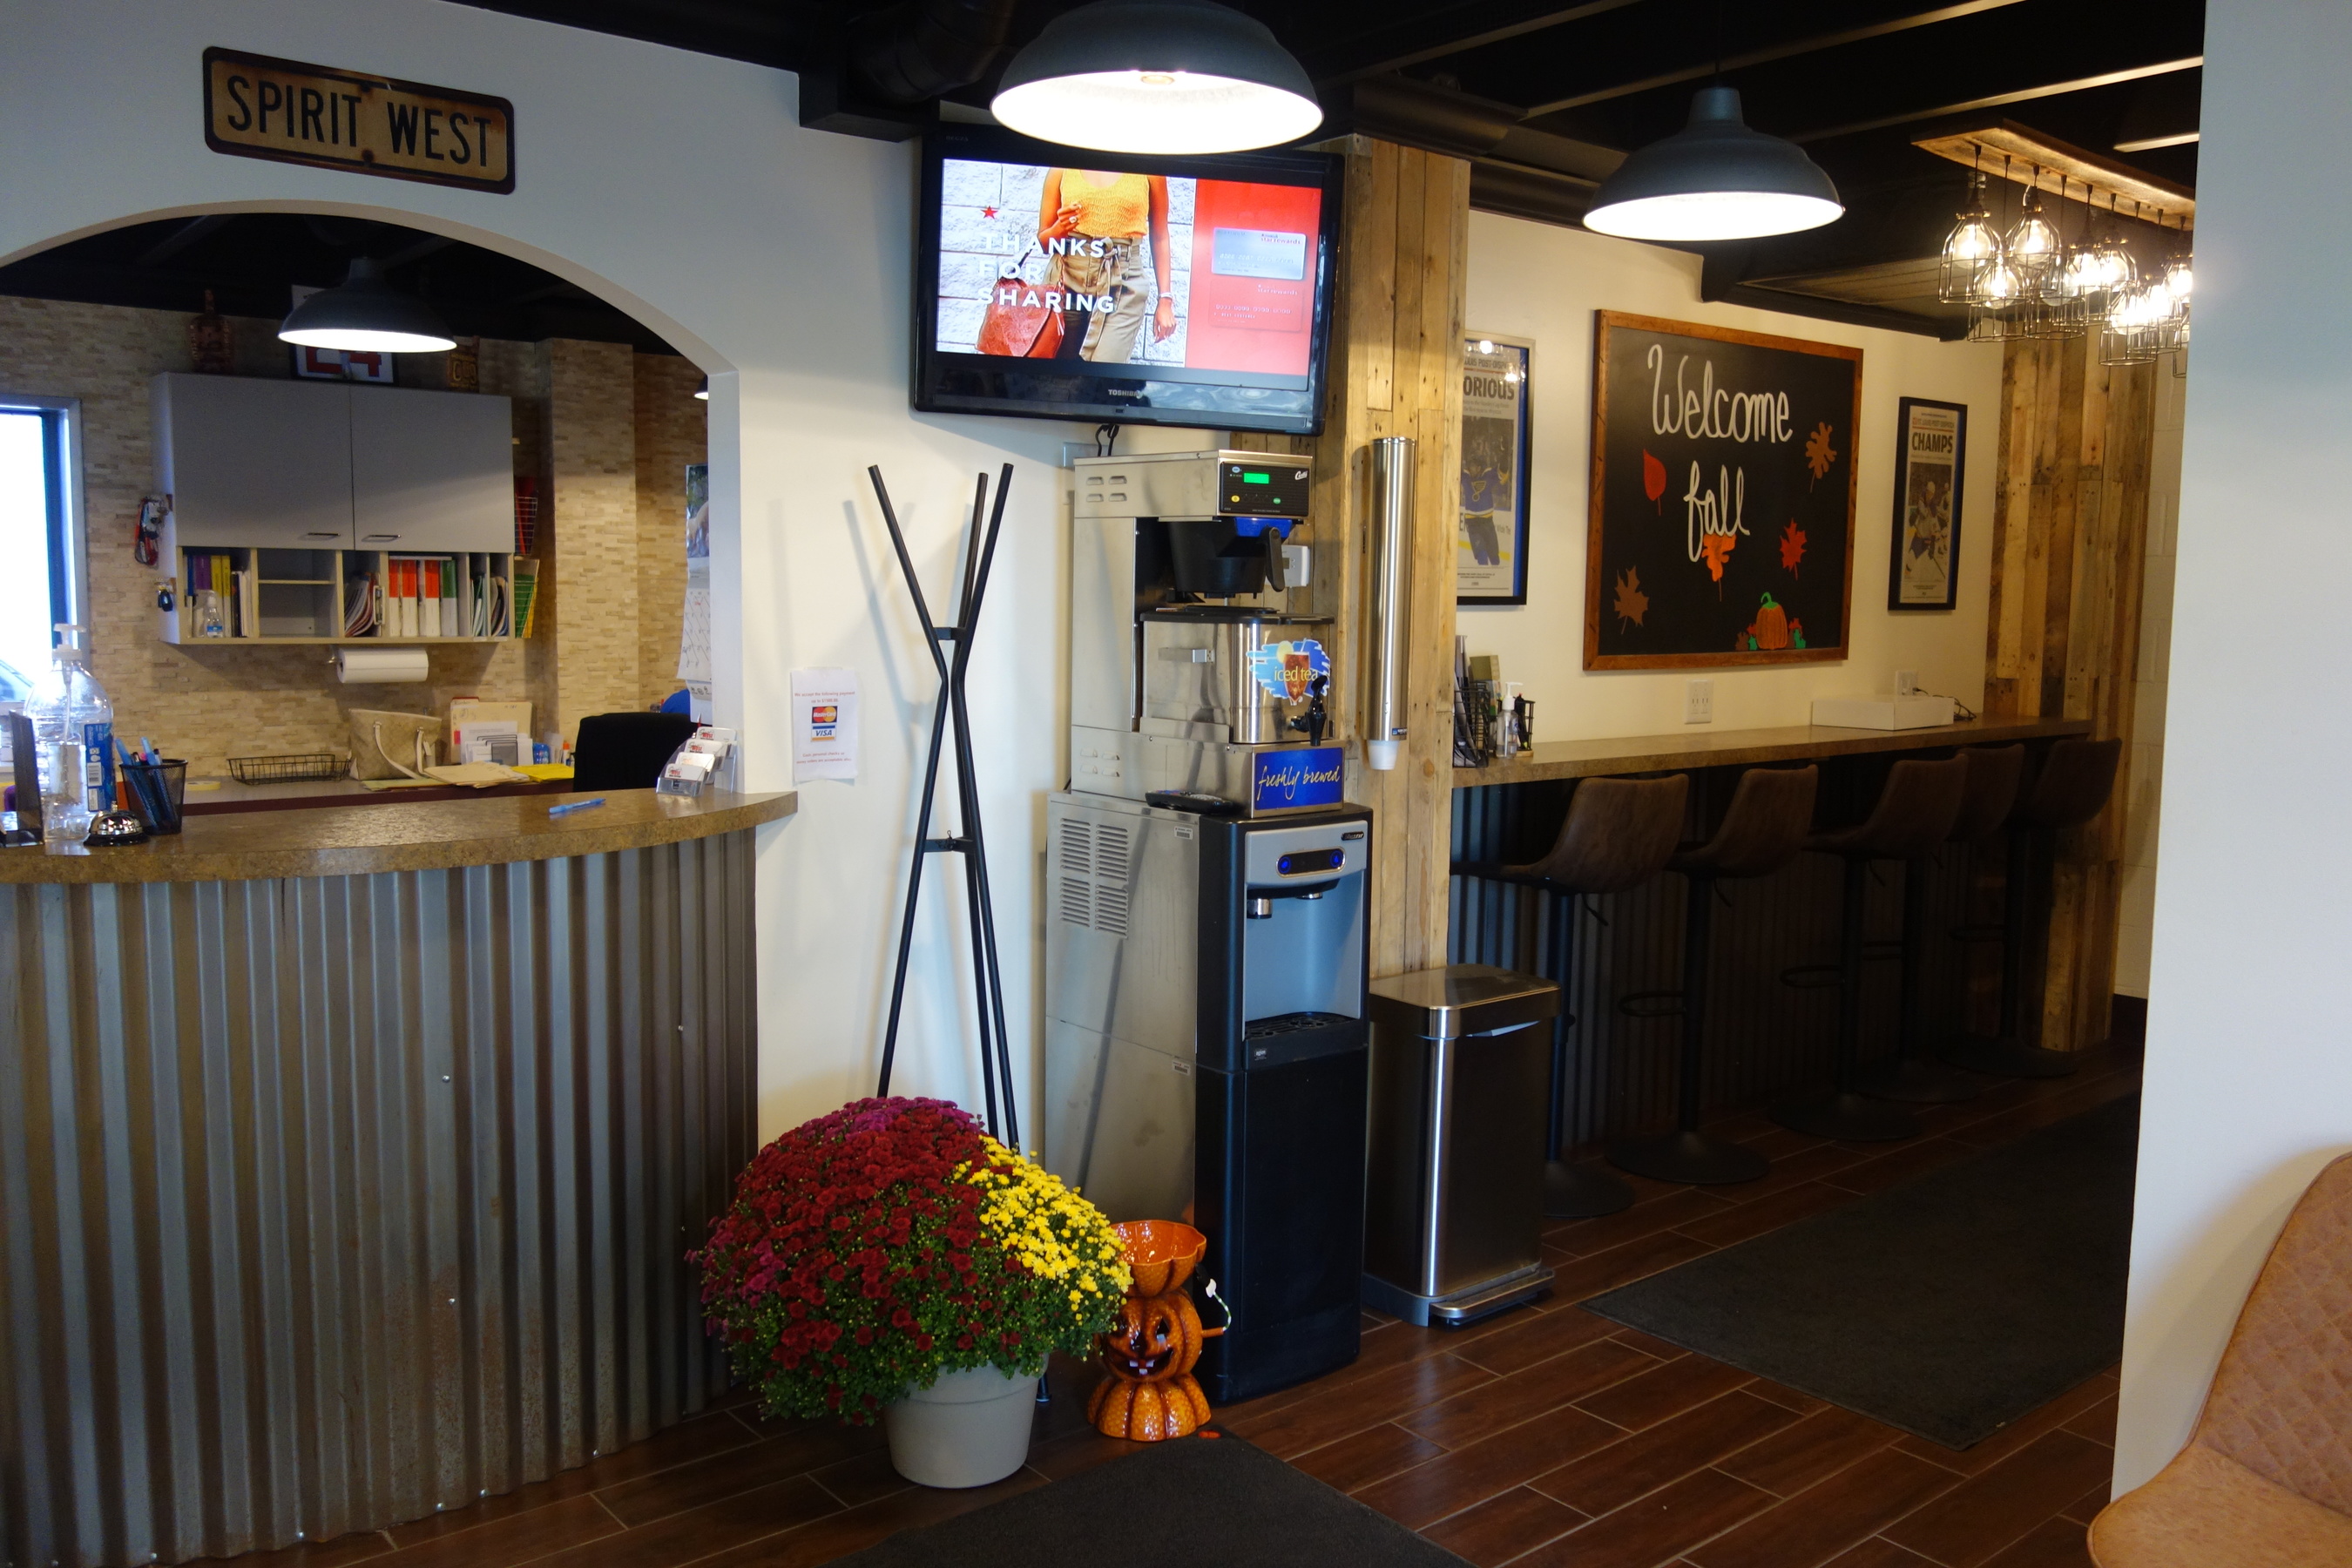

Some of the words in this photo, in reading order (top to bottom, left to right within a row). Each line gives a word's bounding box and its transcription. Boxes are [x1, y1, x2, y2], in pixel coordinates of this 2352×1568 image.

[226, 75, 362, 147] SPIRIT
[387, 101, 492, 167] WEST
[981, 234, 1105, 258] THANKS
[979, 261, 1043, 280] FOR
[977, 287, 1114, 314] SHARING
[1647, 343, 1793, 443] Welcome
[1912, 432, 1953, 454] CHAMPS
[1683, 460, 1751, 563] fall
[1274, 666, 1298, 681] iced
[1301, 667, 1318, 681] tea
[1257, 766, 1301, 801] freshly
[1302, 766, 1341, 785] brewed
